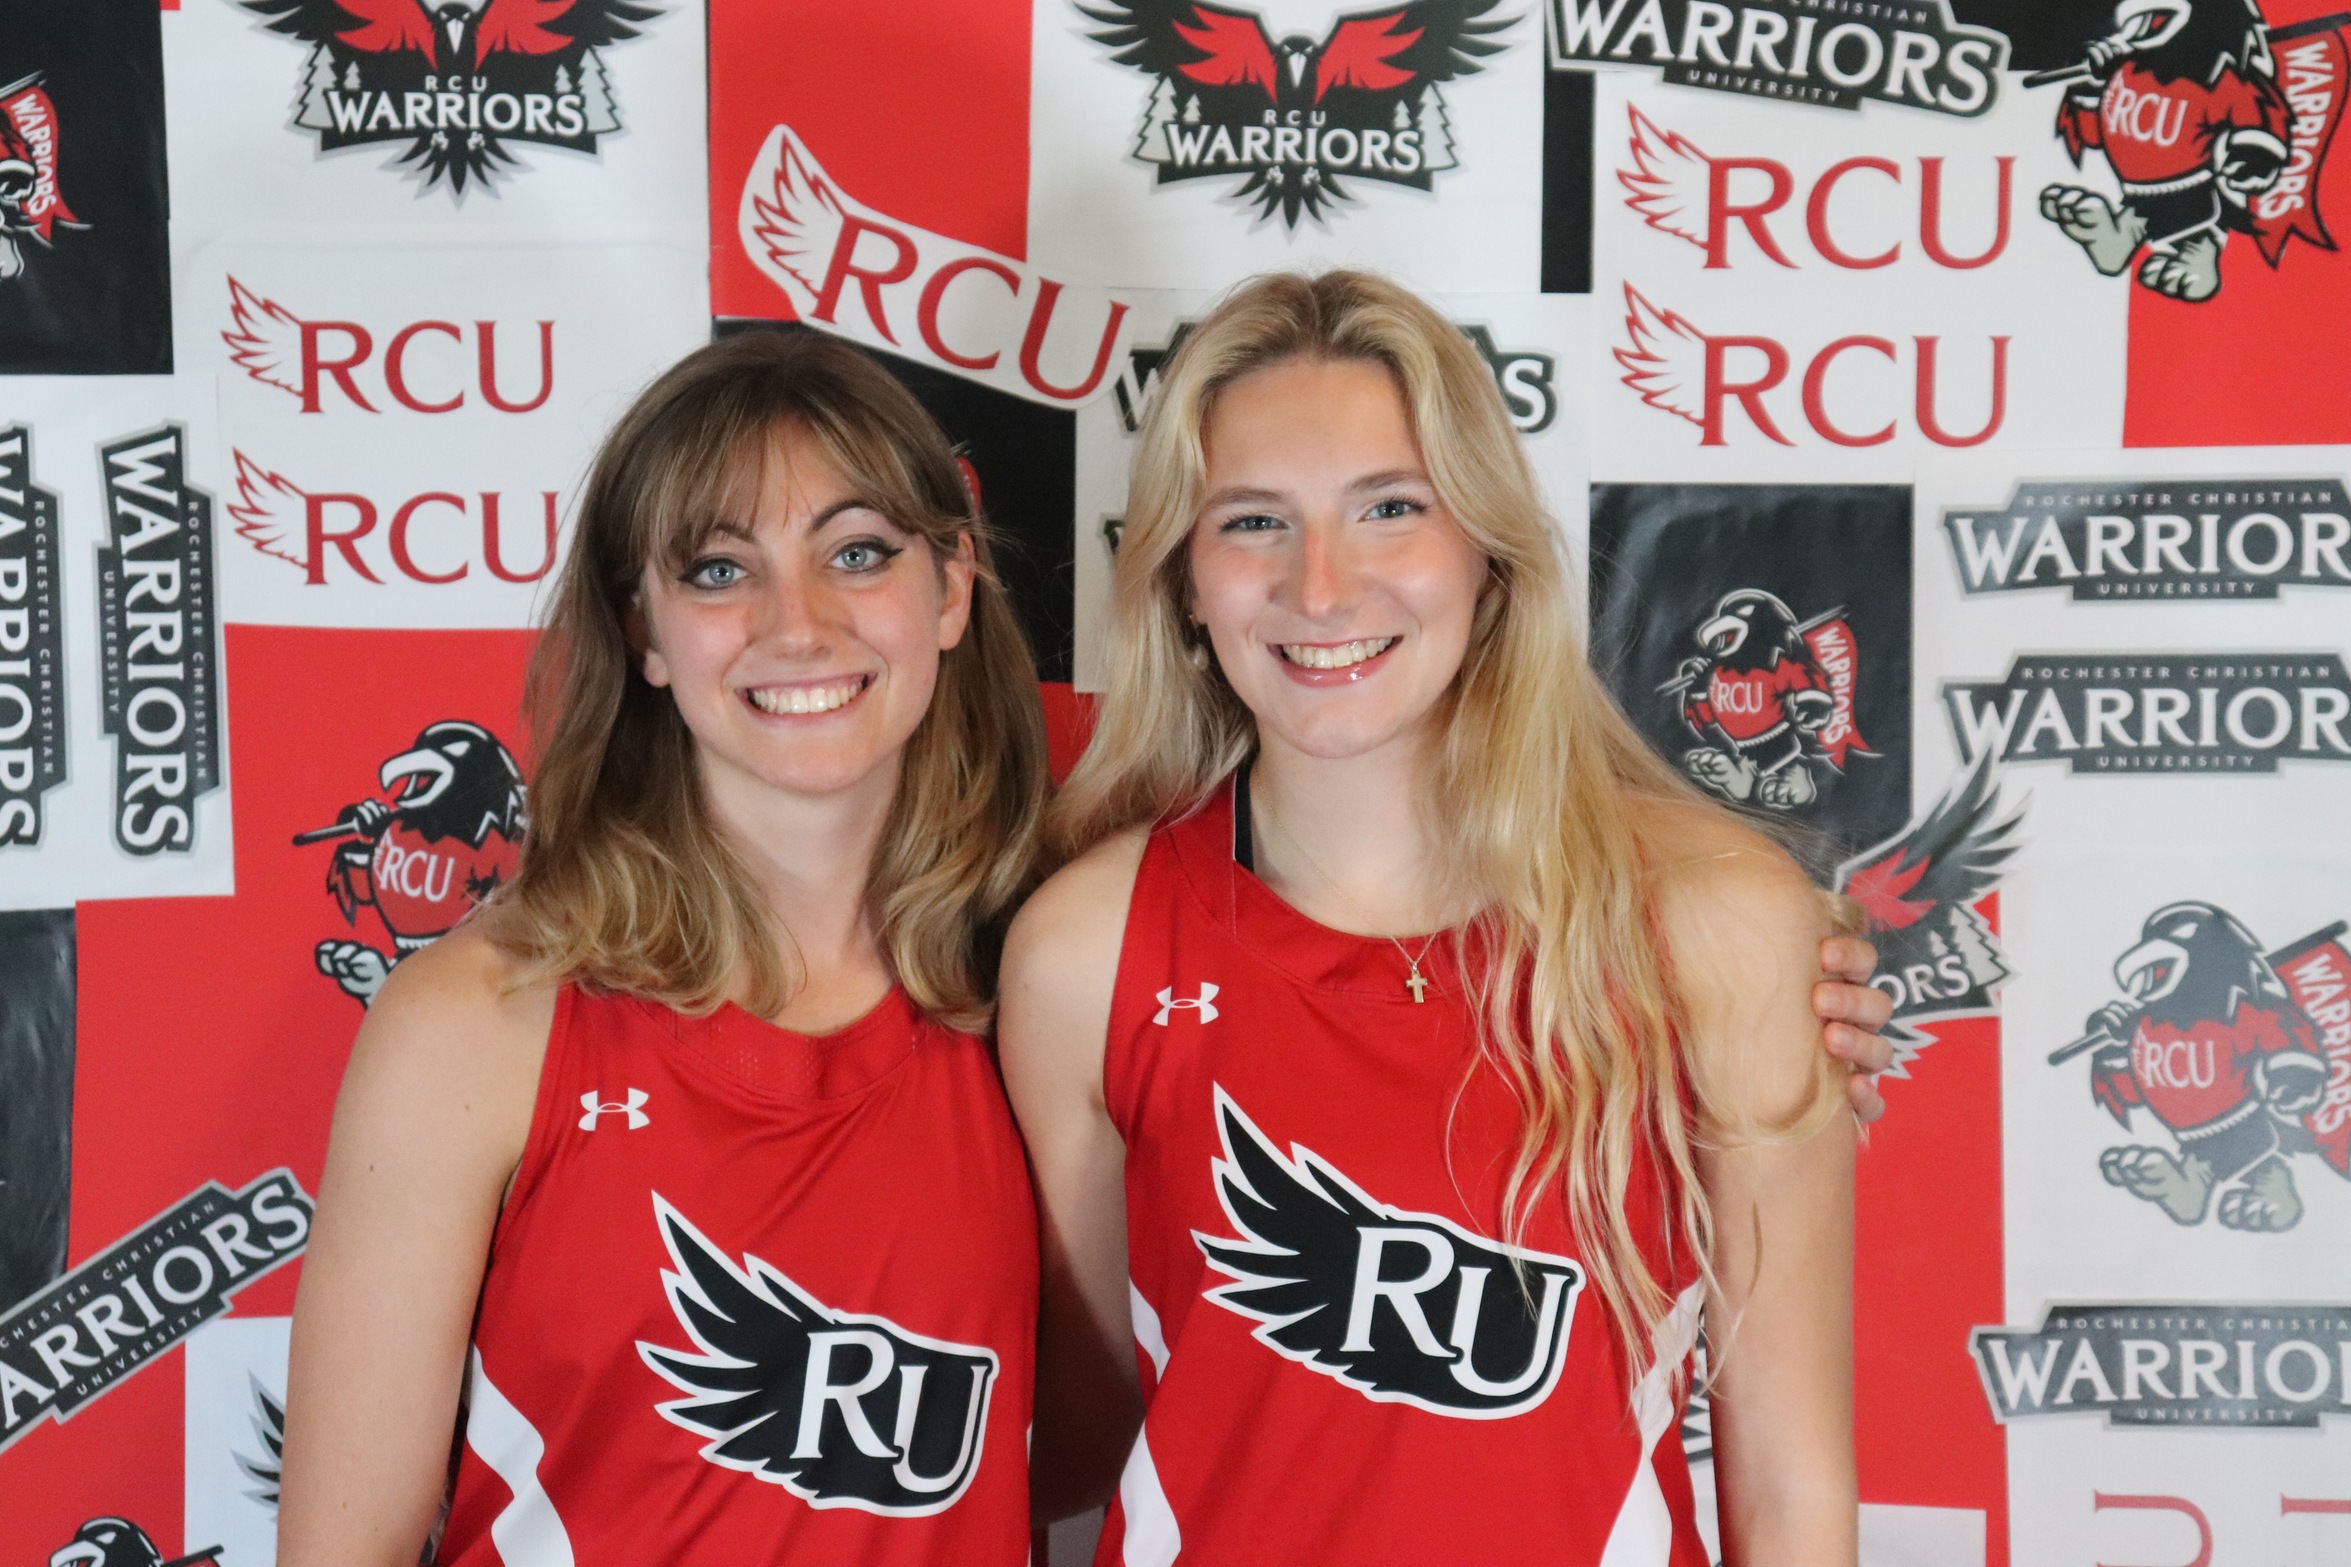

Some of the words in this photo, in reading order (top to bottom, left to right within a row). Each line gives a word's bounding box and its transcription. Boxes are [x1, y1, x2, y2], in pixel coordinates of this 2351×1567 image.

[424, 75, 487, 93] RCU
[1556, 0, 1992, 112] WARRIORS
[1686, 70, 1839, 103] UNIVERSITY
[11, 93, 57, 217] WARRIORS
[329, 91, 584, 137] WARRIORS
[1167, 125, 1421, 171] WARRIORS
[1264, 109, 1326, 126] RCU
[2107, 89, 2188, 146] RCU
[2257, 41, 2334, 220] WARRIORS
[1703, 155, 2018, 269] RCU
[809, 213, 1132, 400] RCU
[299, 320, 556, 414] RCU
[1698, 334, 2014, 447] RCU
[304, 491, 558, 584] RCU
[2026, 494, 2172, 506] ROCHESTER
[2189, 492, 2331, 505] CHRISTIAN
[35, 501, 49, 633] ROCHESTER
[187, 502, 203, 636] ROCHESTER
[2100, 582, 2256, 595] UNIVERSITY
[104, 571, 119, 713] UNIVERSITY
[108, 435, 188, 847] WARRIORS
[1814, 626, 1852, 744] WARRIORS
[2022, 666, 2170, 679] ROCHESTER
[2188, 665, 2330, 678] CHRISTIAN
[39, 648, 53, 773] CHRISTIAN
[193, 651, 206, 778] CHRISTIAN
[1714, 682, 1763, 714] RCU
[2099, 755, 2255, 768] UNIVERSITY
[380, 845, 454, 902] RCU
[2145, 1040, 2215, 1089] RCU
[103, 1201, 215, 1280] CHRISTIAN
[77, 1307, 202, 1397] UNIVERSITY
[1339, 1226, 1571, 1397] RU
[2058, 1318, 2207, 1331] ROCHESTER
[790, 1330, 989, 1492] RU
[1986, 1338, 2351, 1410] WARRIO
[2135, 1408, 2297, 1421] UNIVERSITY
